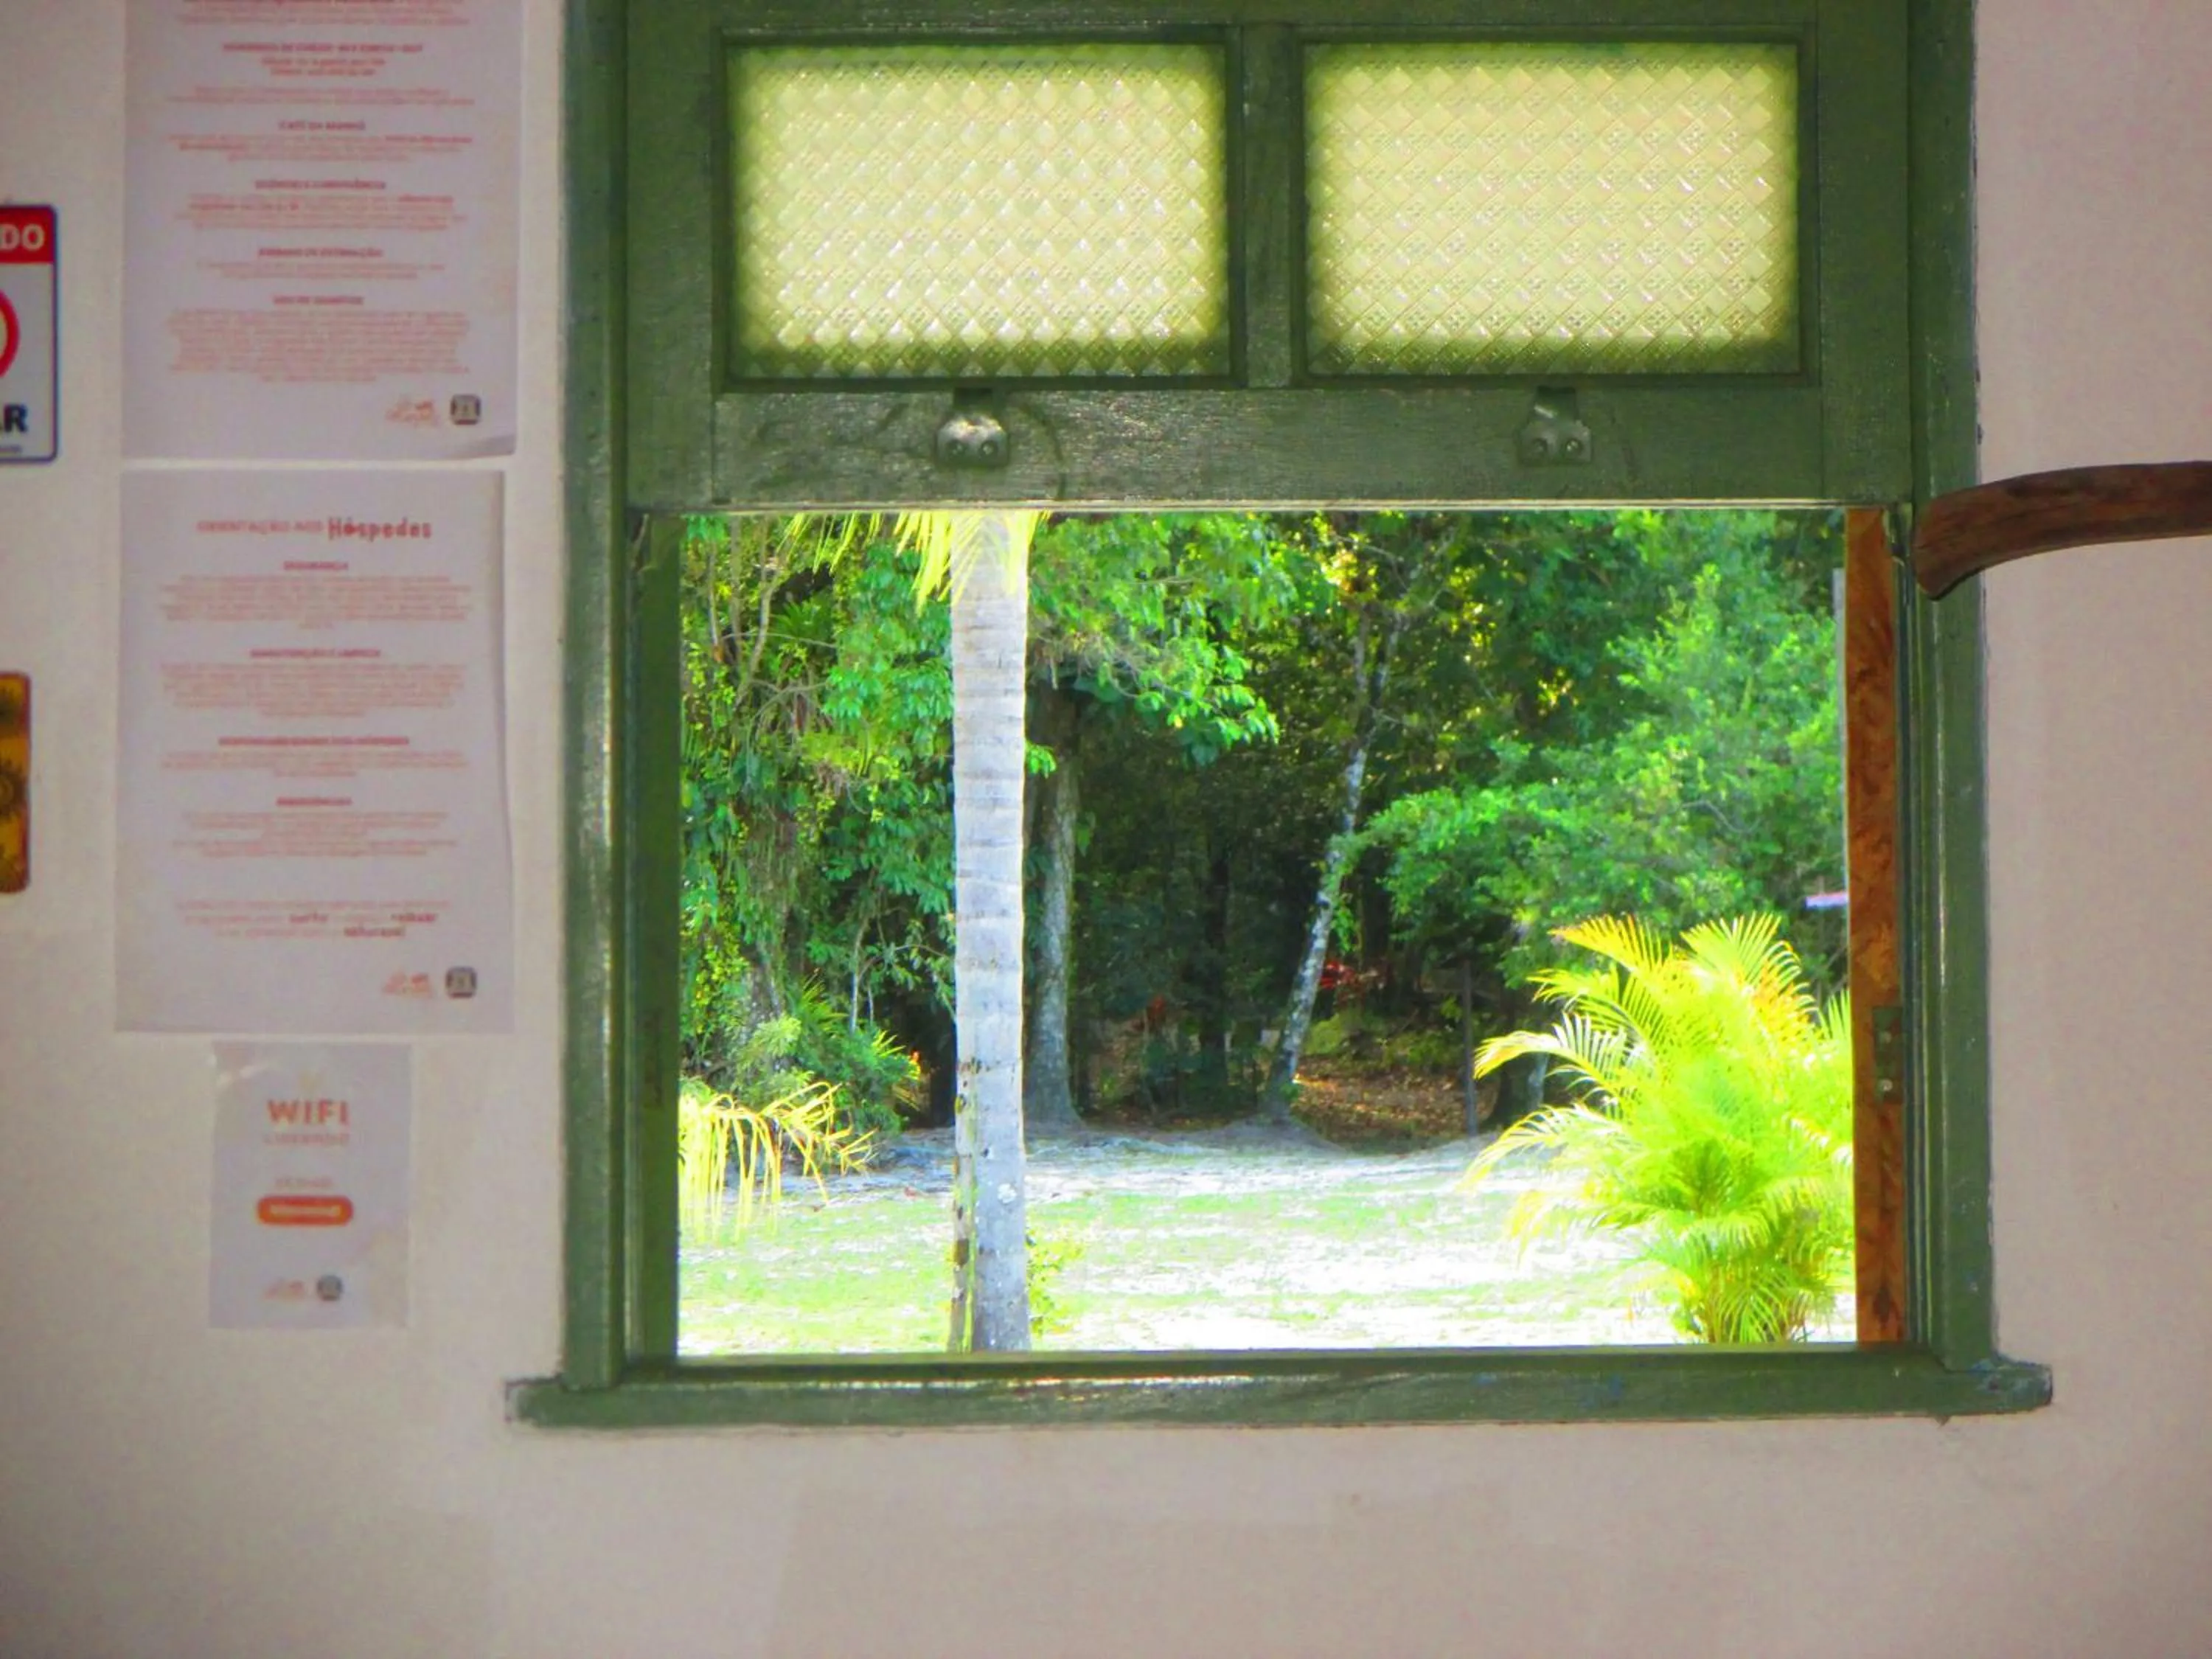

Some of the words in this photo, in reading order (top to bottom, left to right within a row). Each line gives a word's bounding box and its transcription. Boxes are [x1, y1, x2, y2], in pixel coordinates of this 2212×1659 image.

[0, 223, 45, 251] DO
[0, 404, 27, 433] R
[268, 1099, 349, 1125] WIFI
